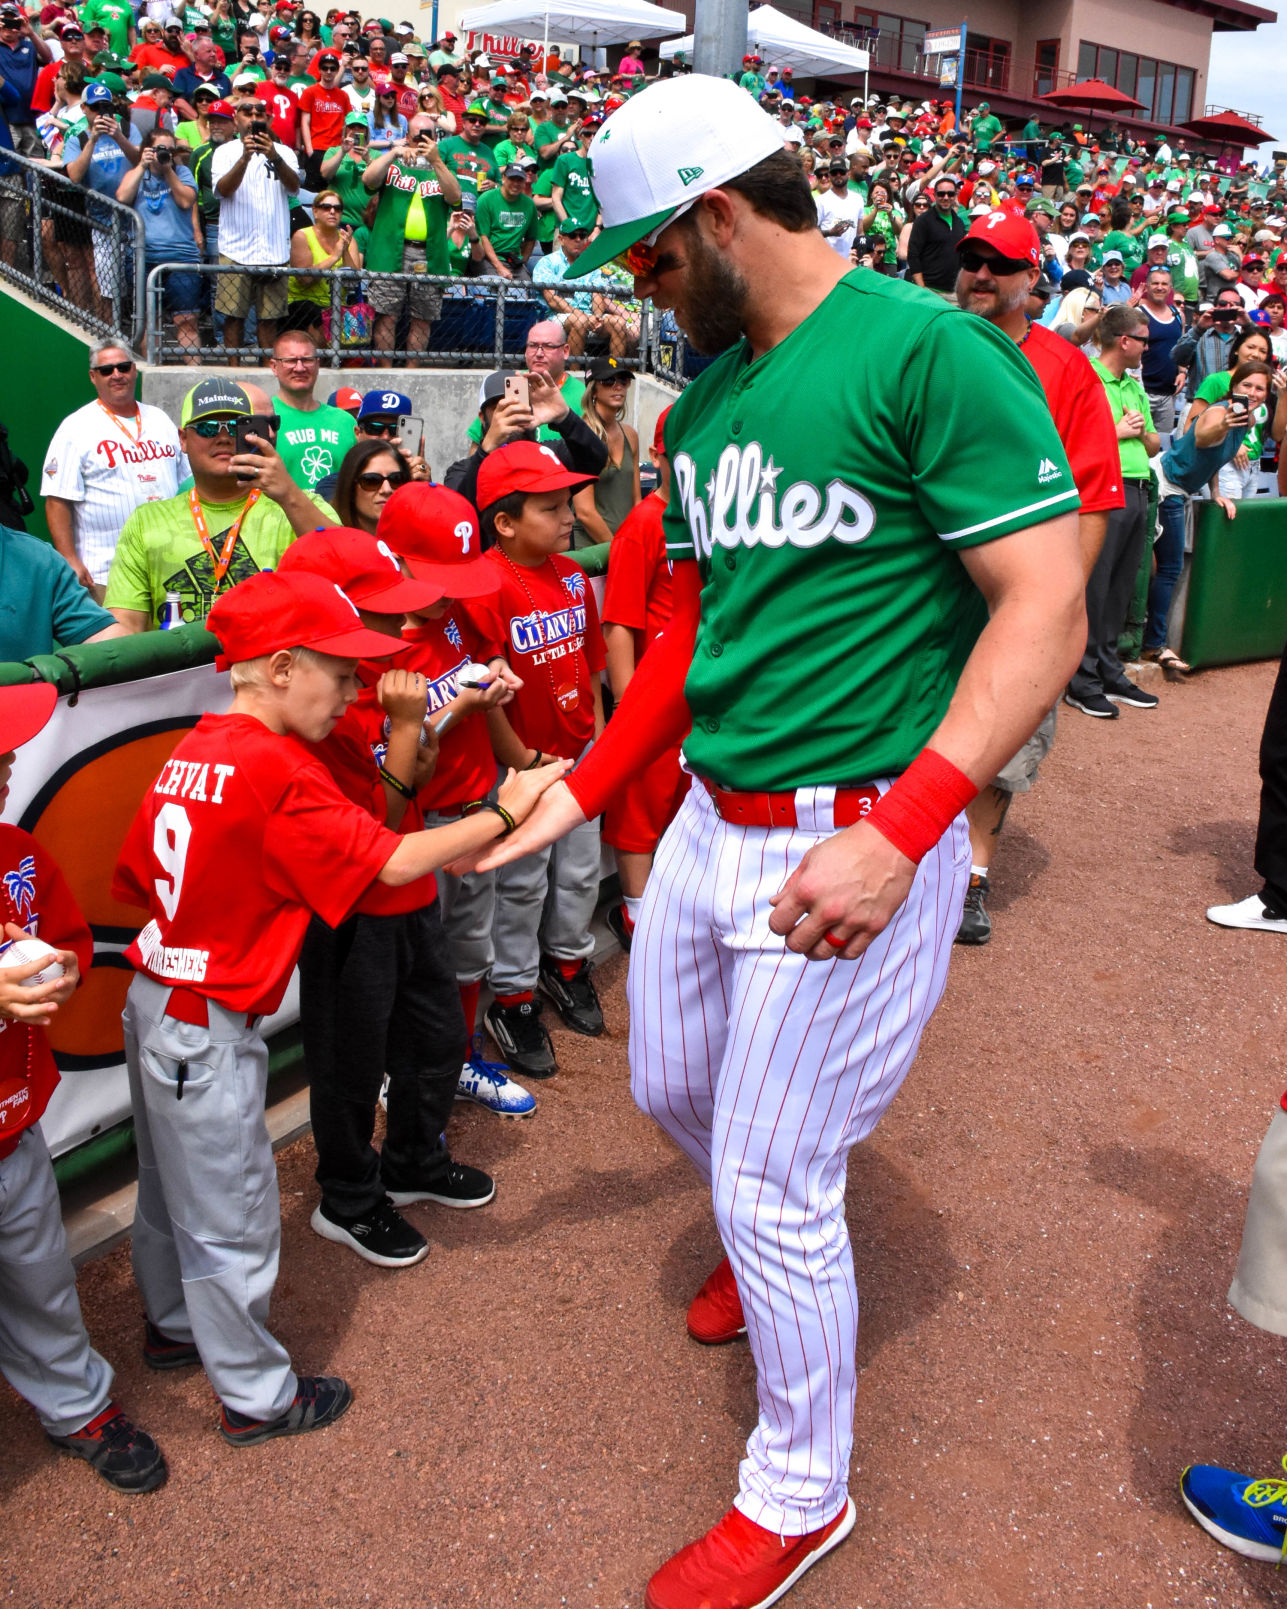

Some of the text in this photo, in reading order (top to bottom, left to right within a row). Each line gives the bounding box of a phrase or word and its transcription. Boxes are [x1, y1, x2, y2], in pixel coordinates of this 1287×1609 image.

[274, 94, 291, 119] P
[987, 212, 1006, 229] P
[382, 393, 400, 409] D
[285, 428, 339, 445] RUB ME
[97, 440, 175, 468] Phillie
[454, 521, 473, 554] P
[153, 802, 192, 922] 9
[0, 1087, 28, 1106] THENTIC
